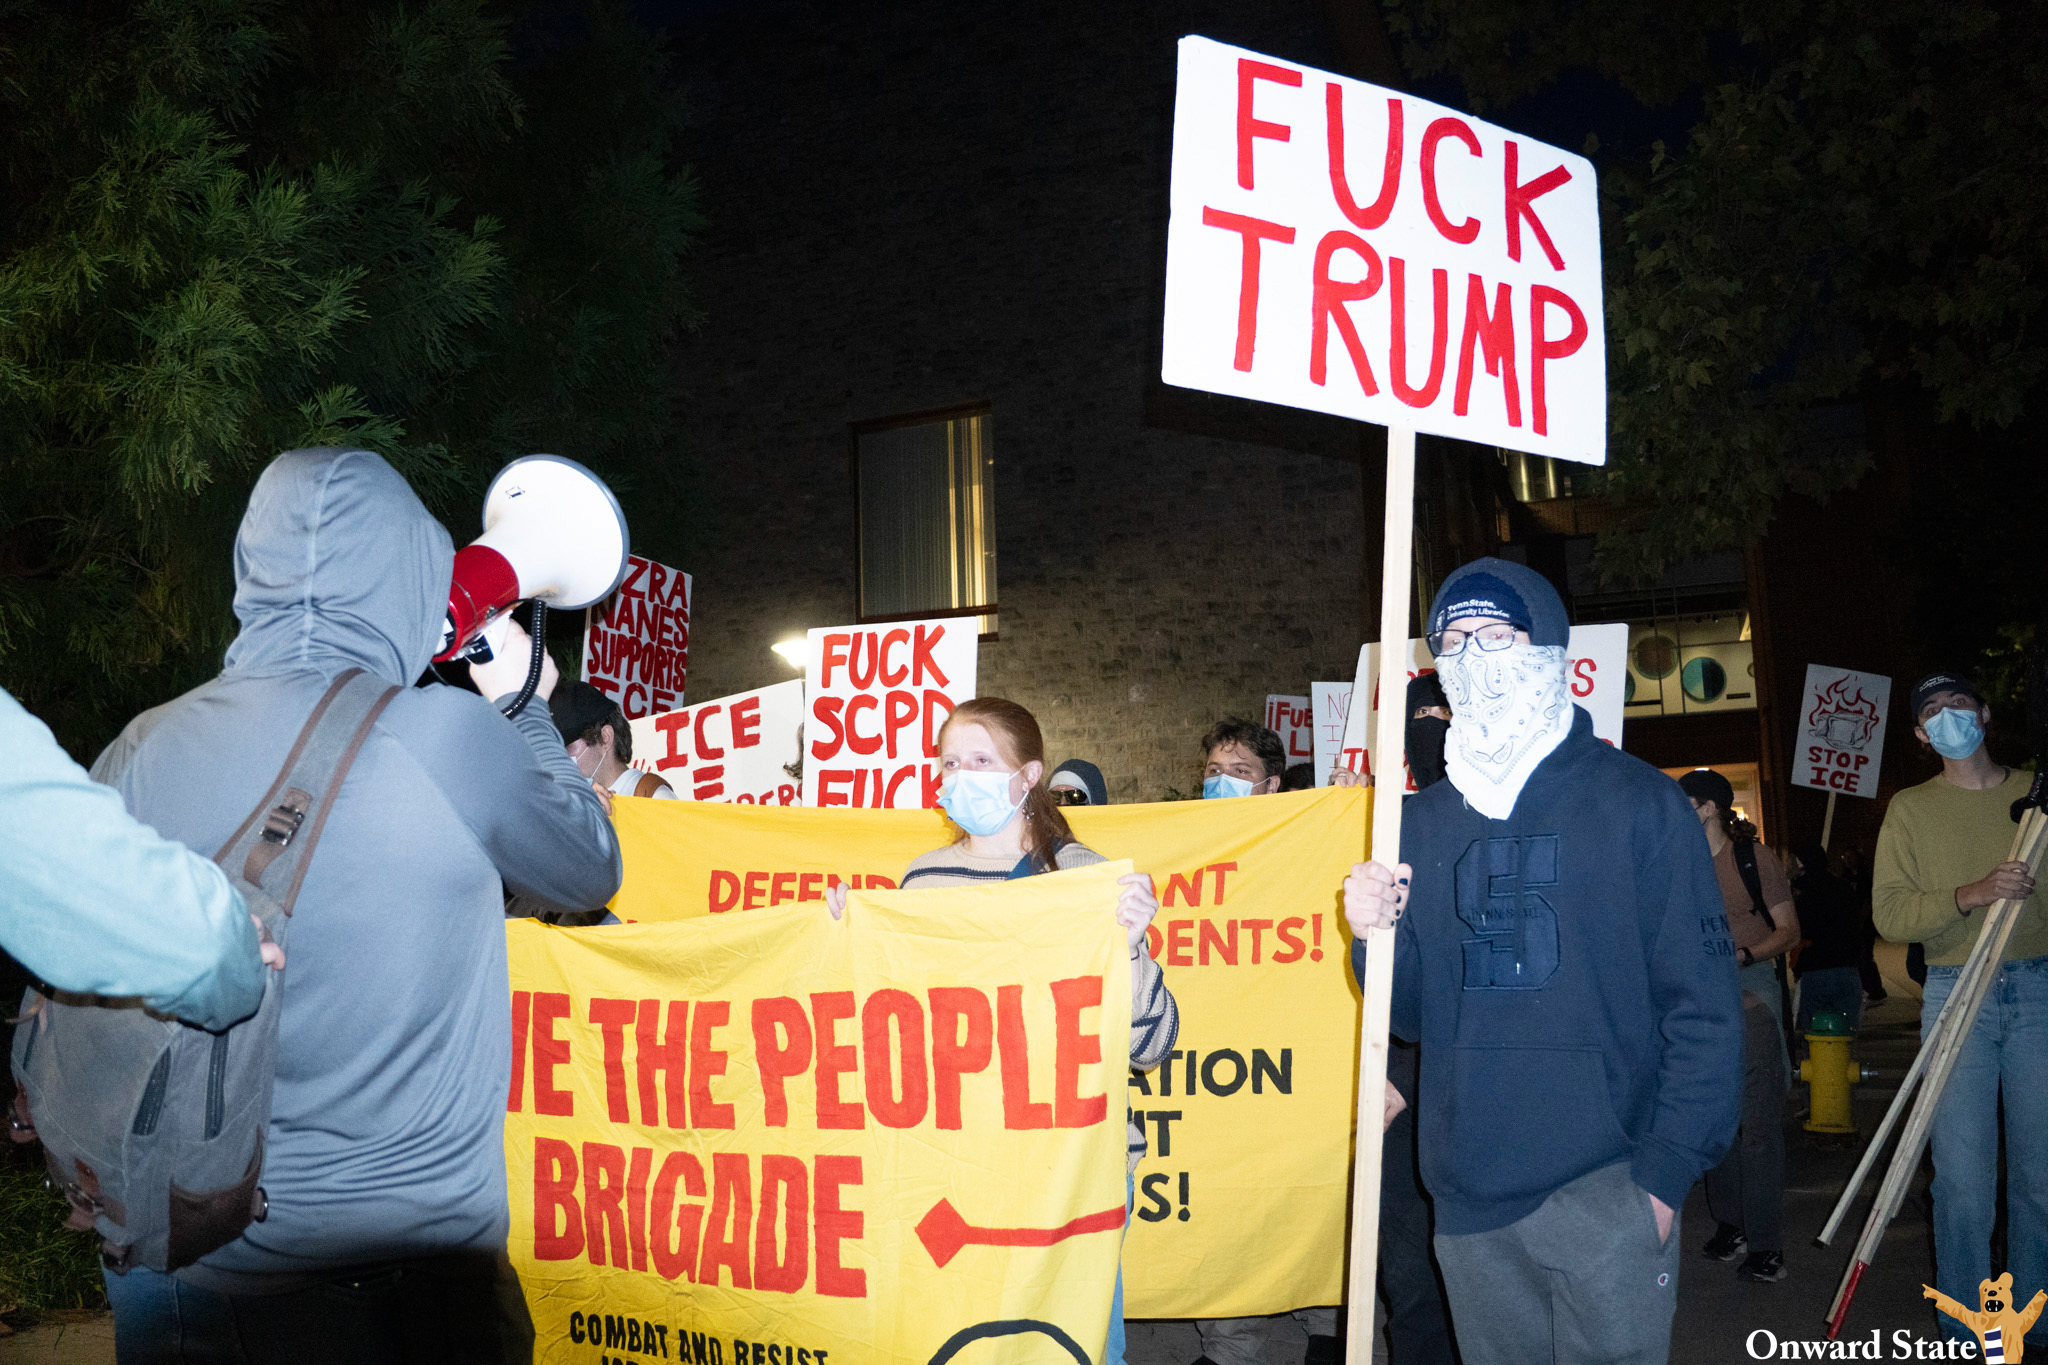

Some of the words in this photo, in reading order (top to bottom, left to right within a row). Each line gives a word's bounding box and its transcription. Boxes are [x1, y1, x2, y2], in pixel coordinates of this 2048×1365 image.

[1237, 58, 1573, 271] FUCK
[1202, 205, 1589, 437] TRUMP
[591, 590, 689, 651] NANES
[1478, 606, 1510, 618] Libraries
[587, 625, 687, 693] SUPPORTS
[822, 624, 951, 690] FUCK
[655, 696, 761, 772] ICE
[811, 689, 957, 762] SCPD
[1808, 745, 1870, 771] STOP
[1810, 766, 1861, 793] ICE
[1454, 834, 1561, 991] S
[589, 997, 736, 1130] THE
[751, 975, 1108, 1131] PEOPLE
[533, 1136, 867, 1298] BRIGADE
[570, 1311, 668, 1358] COMBAT
[678, 1329, 723, 1365] AND
